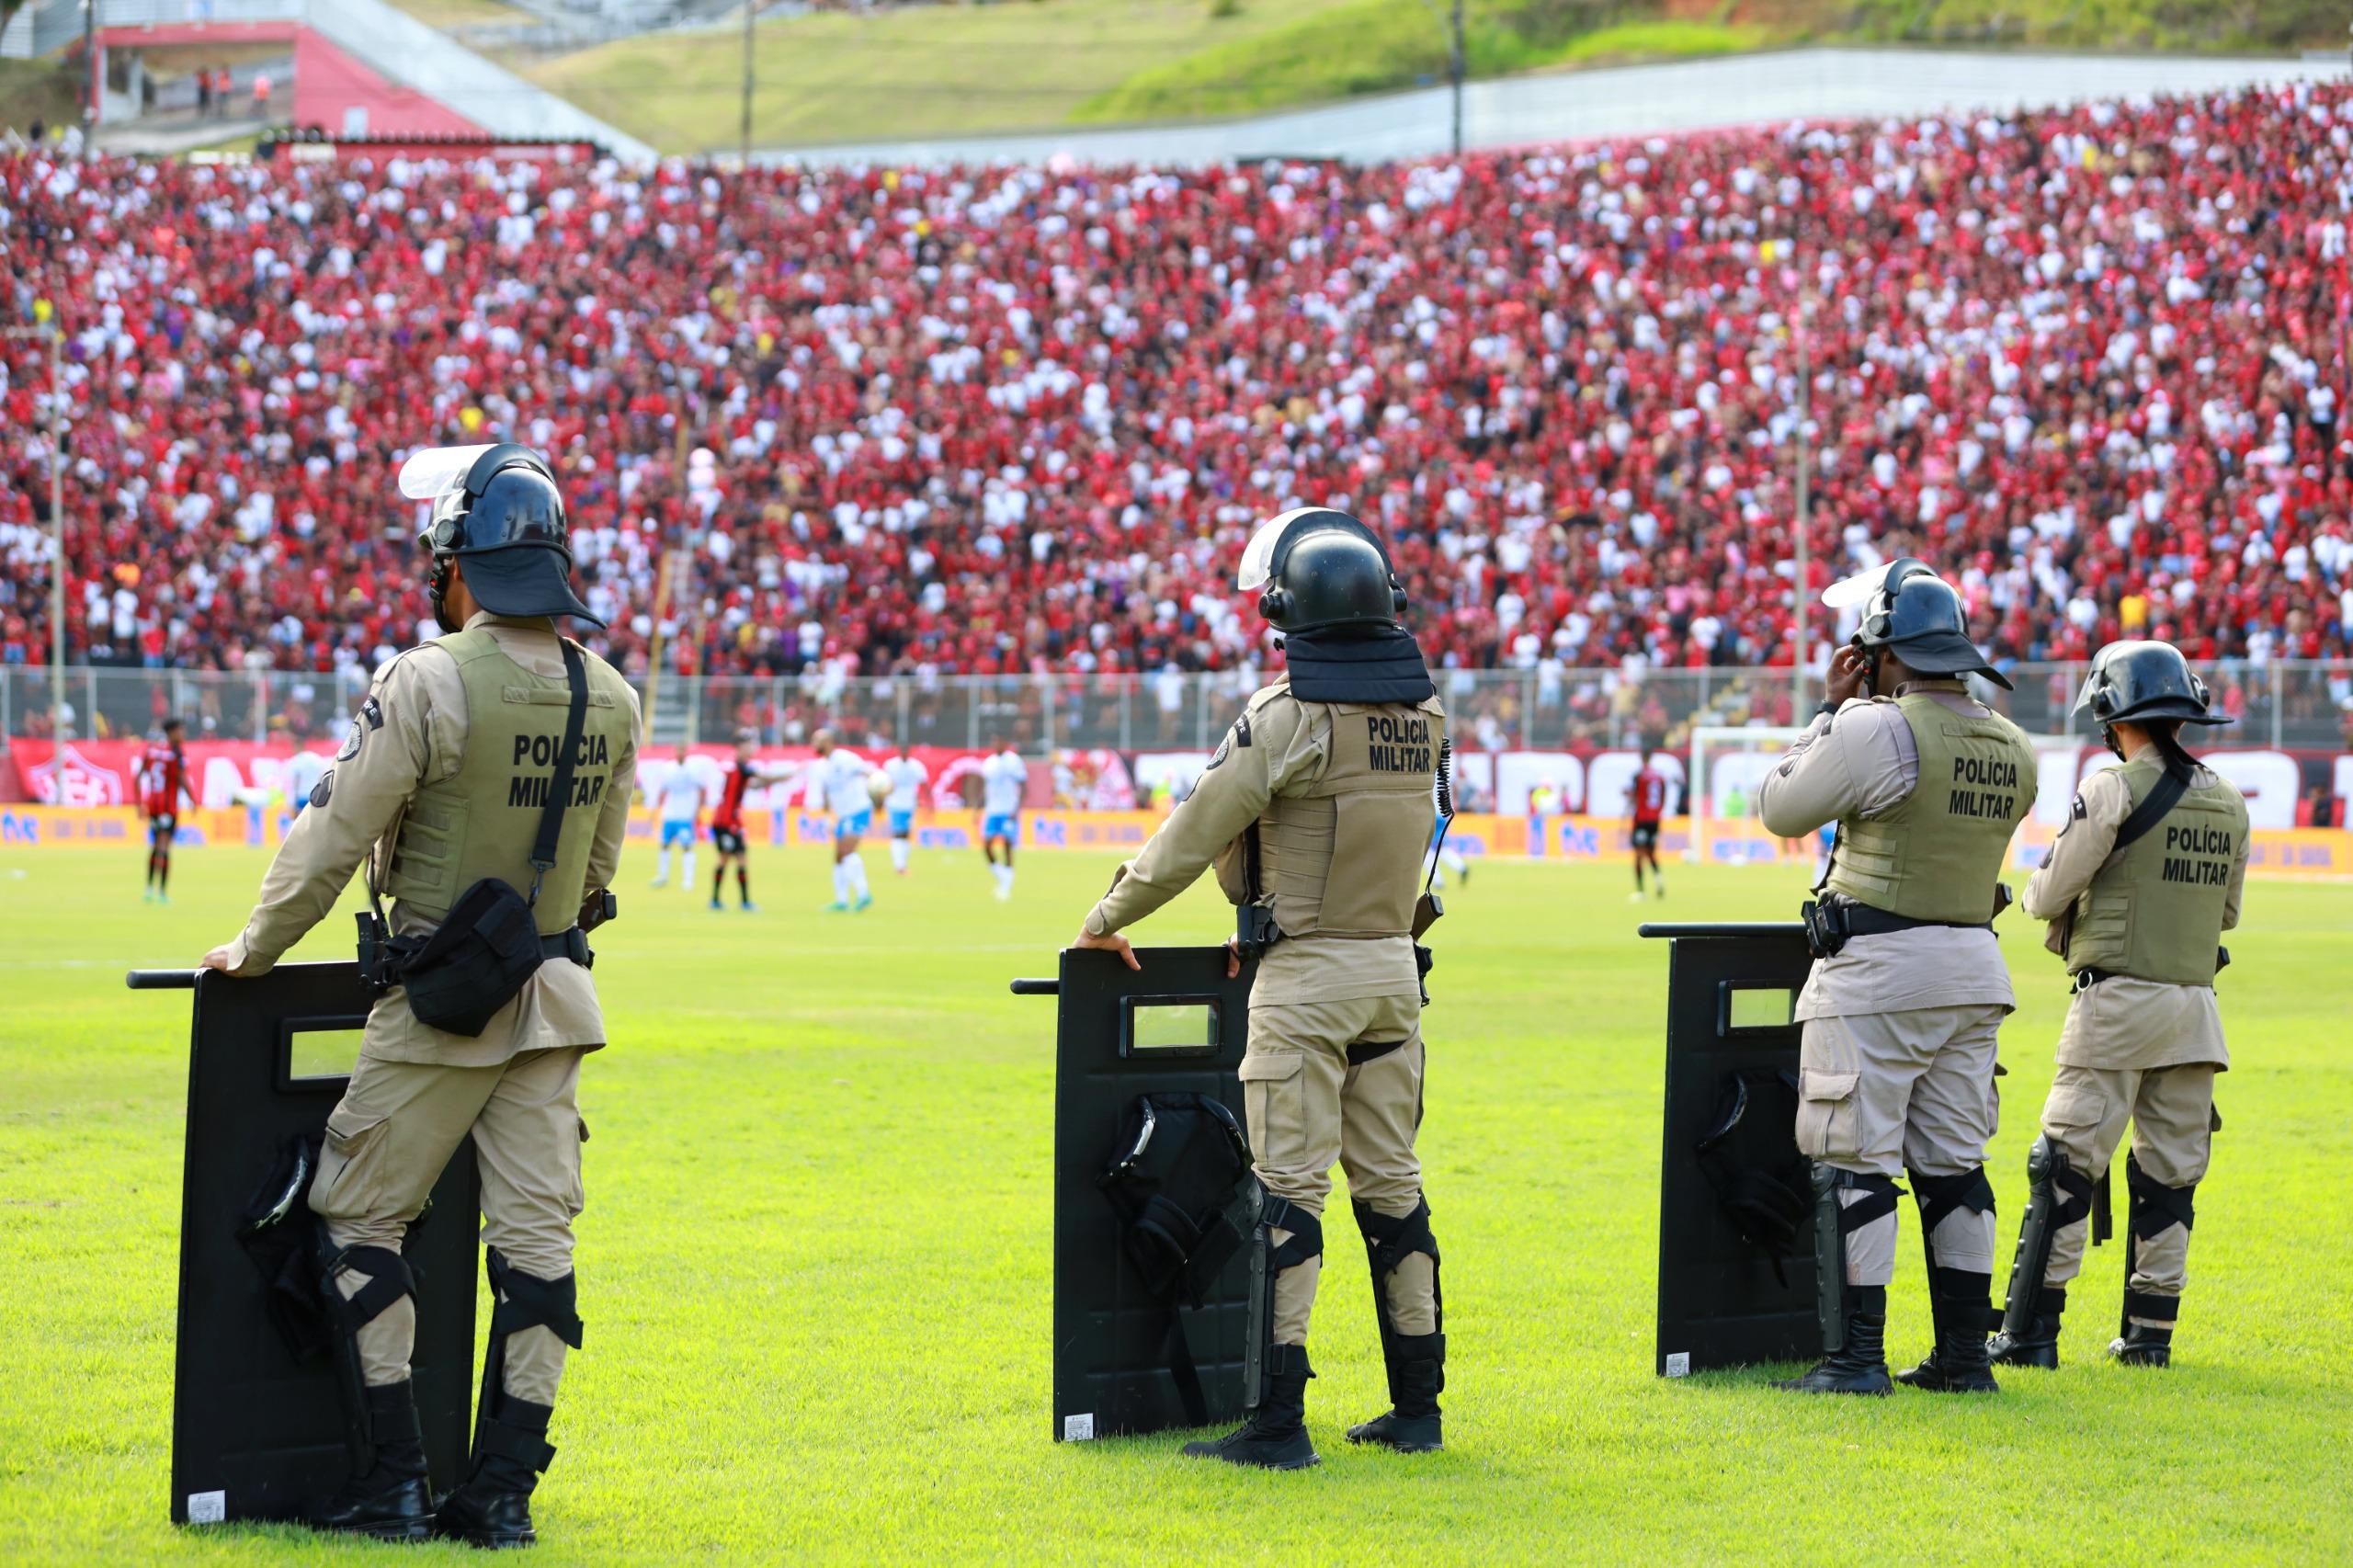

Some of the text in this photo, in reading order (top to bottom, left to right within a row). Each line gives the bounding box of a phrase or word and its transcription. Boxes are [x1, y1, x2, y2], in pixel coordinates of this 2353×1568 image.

[1367, 714, 1430, 744] POLÍCIA
[513, 734, 608, 767] POLCIA
[1369, 745, 1430, 773] MILITAR
[1953, 755, 2018, 789] POLÍCIA
[507, 776, 605, 808] MILTAR
[1949, 790, 2015, 820] MILITAR
[2166, 824, 2231, 857] POLÍCIA
[2162, 858, 2229, 886] MILITAR
